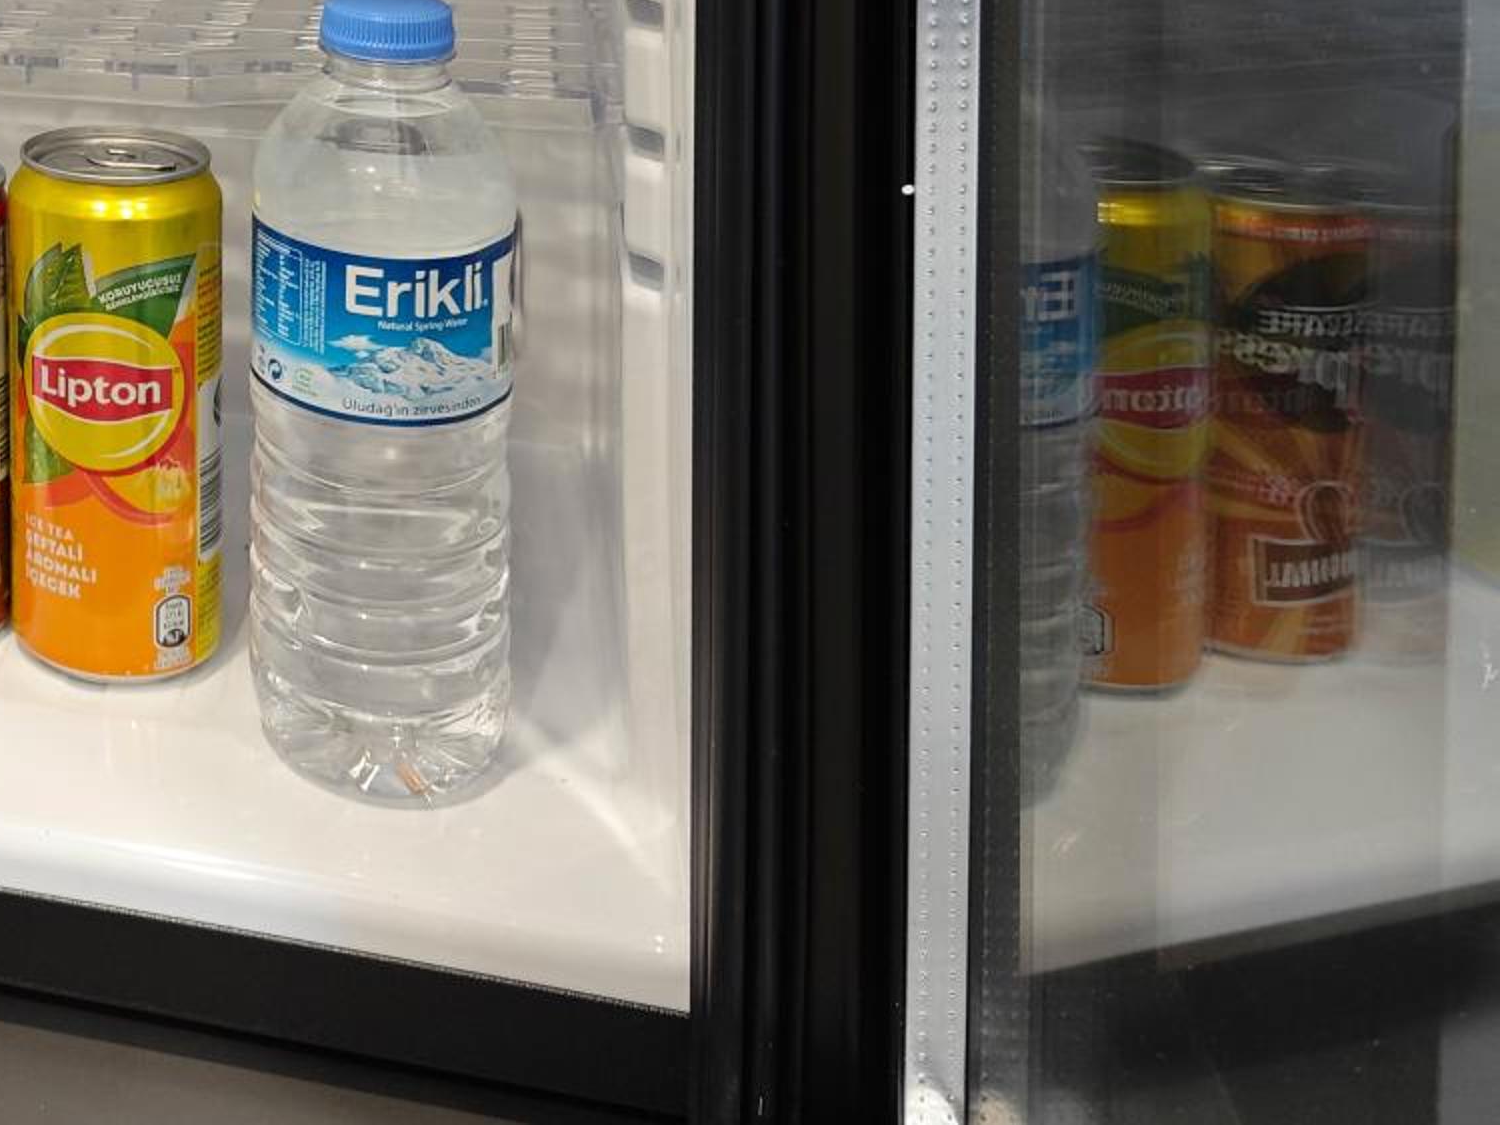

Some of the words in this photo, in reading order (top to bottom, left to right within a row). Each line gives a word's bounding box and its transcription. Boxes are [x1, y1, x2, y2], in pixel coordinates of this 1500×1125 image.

[345, 261, 484, 318] Erikli
[39, 364, 162, 407] Lipton
[26, 548, 97, 585] AROMALI
